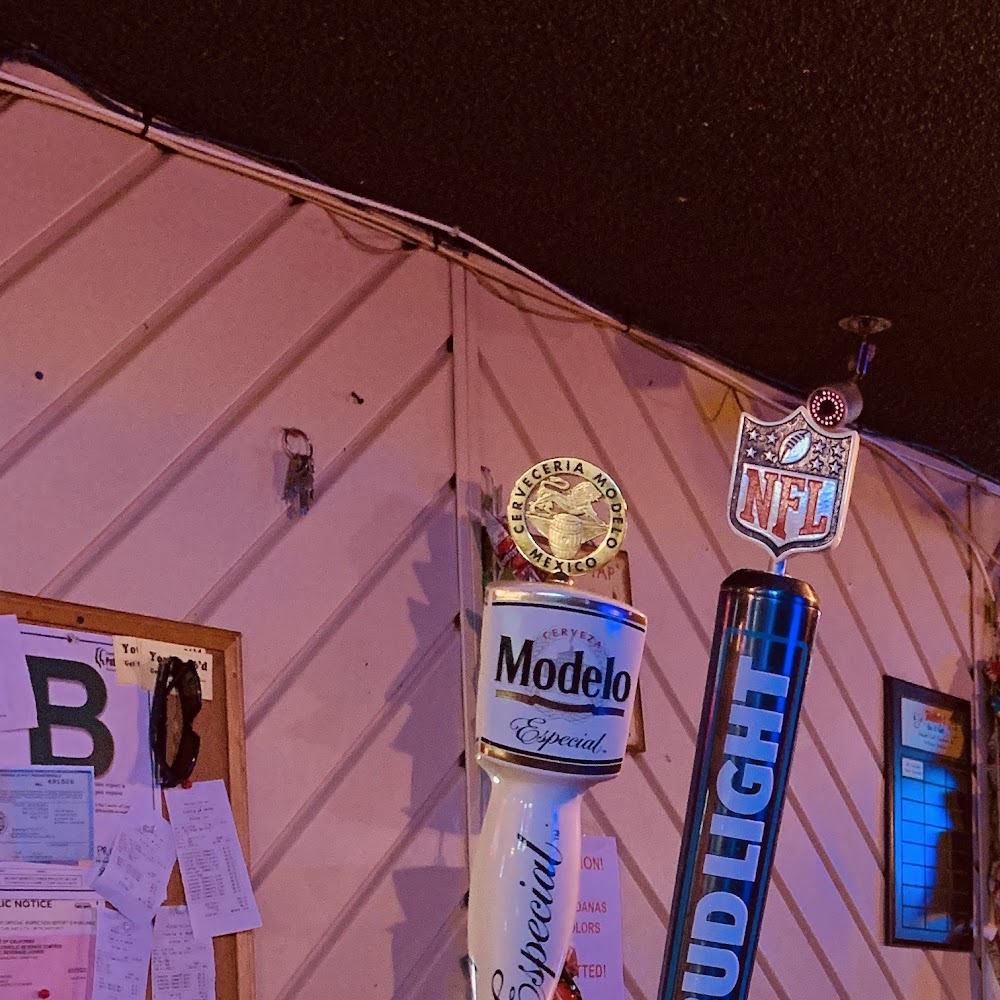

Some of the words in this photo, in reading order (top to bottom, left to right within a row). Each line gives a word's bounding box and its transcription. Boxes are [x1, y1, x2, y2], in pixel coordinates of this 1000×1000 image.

[510, 459, 585, 535] CERVECERIA
[593, 472, 625, 549] MODELO
[739, 467, 828, 541] NFL
[528, 547, 598, 573] MEXICO
[542, 627, 602, 649] CERVEZA
[493, 634, 632, 703] Modelo
[25, 654, 115, 778] B
[509, 717, 607, 754] Especial
[702, 655, 791, 883] LIGHT
[14, 899, 53, 909] NOTICE
[576, 901, 607, 914] DANAS
[571, 921, 601, 934] LORS
[577, 963, 607, 979] TTED!
